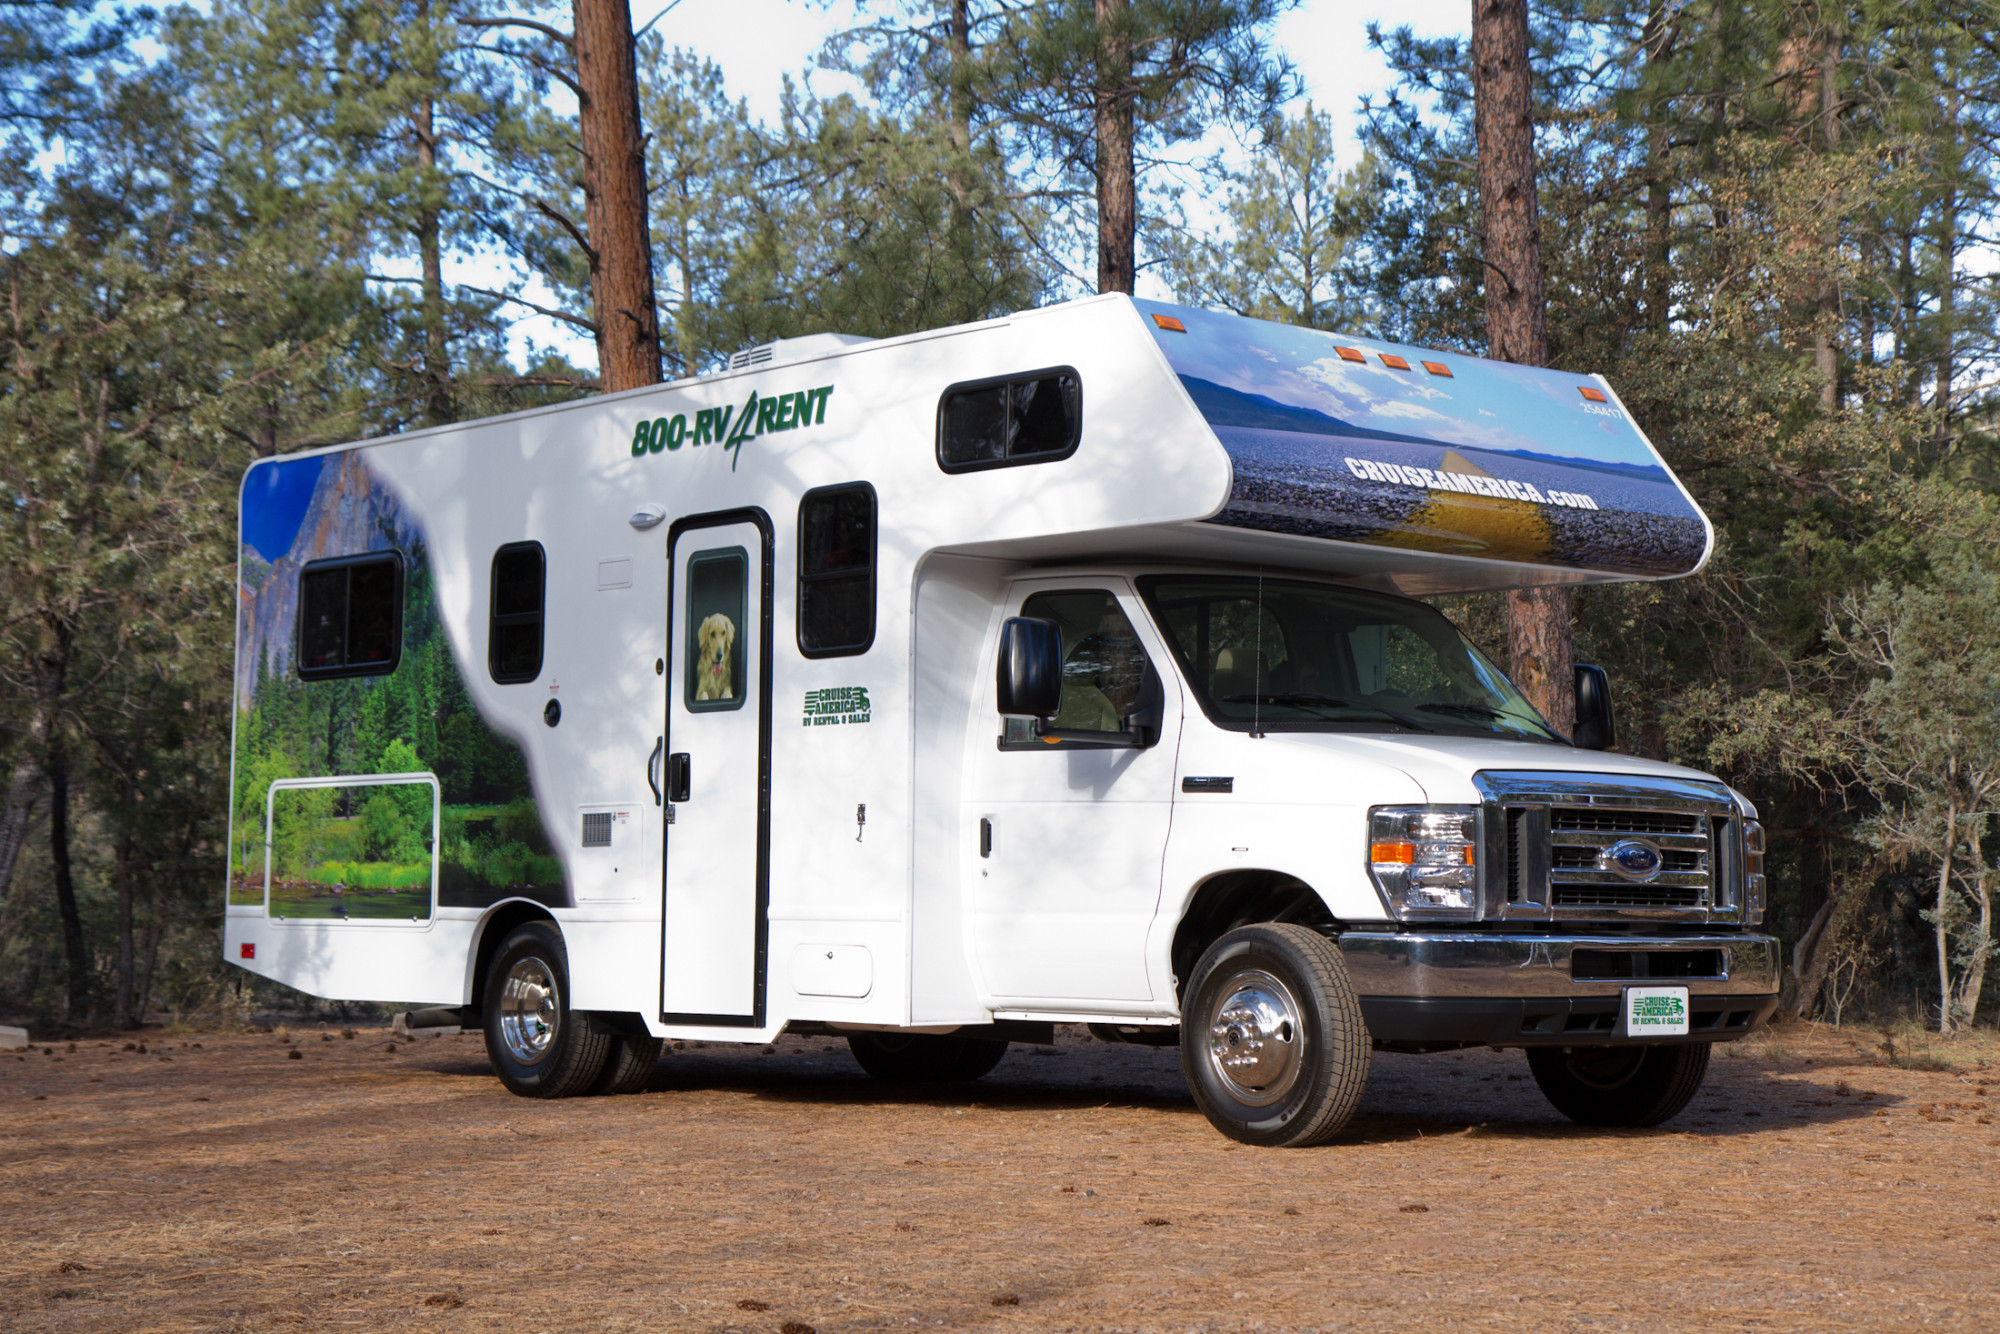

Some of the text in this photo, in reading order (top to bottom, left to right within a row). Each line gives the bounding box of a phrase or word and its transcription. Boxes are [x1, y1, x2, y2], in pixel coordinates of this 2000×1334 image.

[1580, 402, 1622, 419] 254417
[1344, 457, 1599, 510] CRUISEAMERICA.com
[819, 687, 852, 701] CRUISE
[815, 700, 856, 714] AMERICA
[803, 713, 870, 727] RV RENTAL & SALES
[1644, 997, 1670, 1006] CRUISE
[1641, 1007, 1673, 1016] AMERICA
[1632, 1017, 1684, 1025] RV RENTAL & SALES
